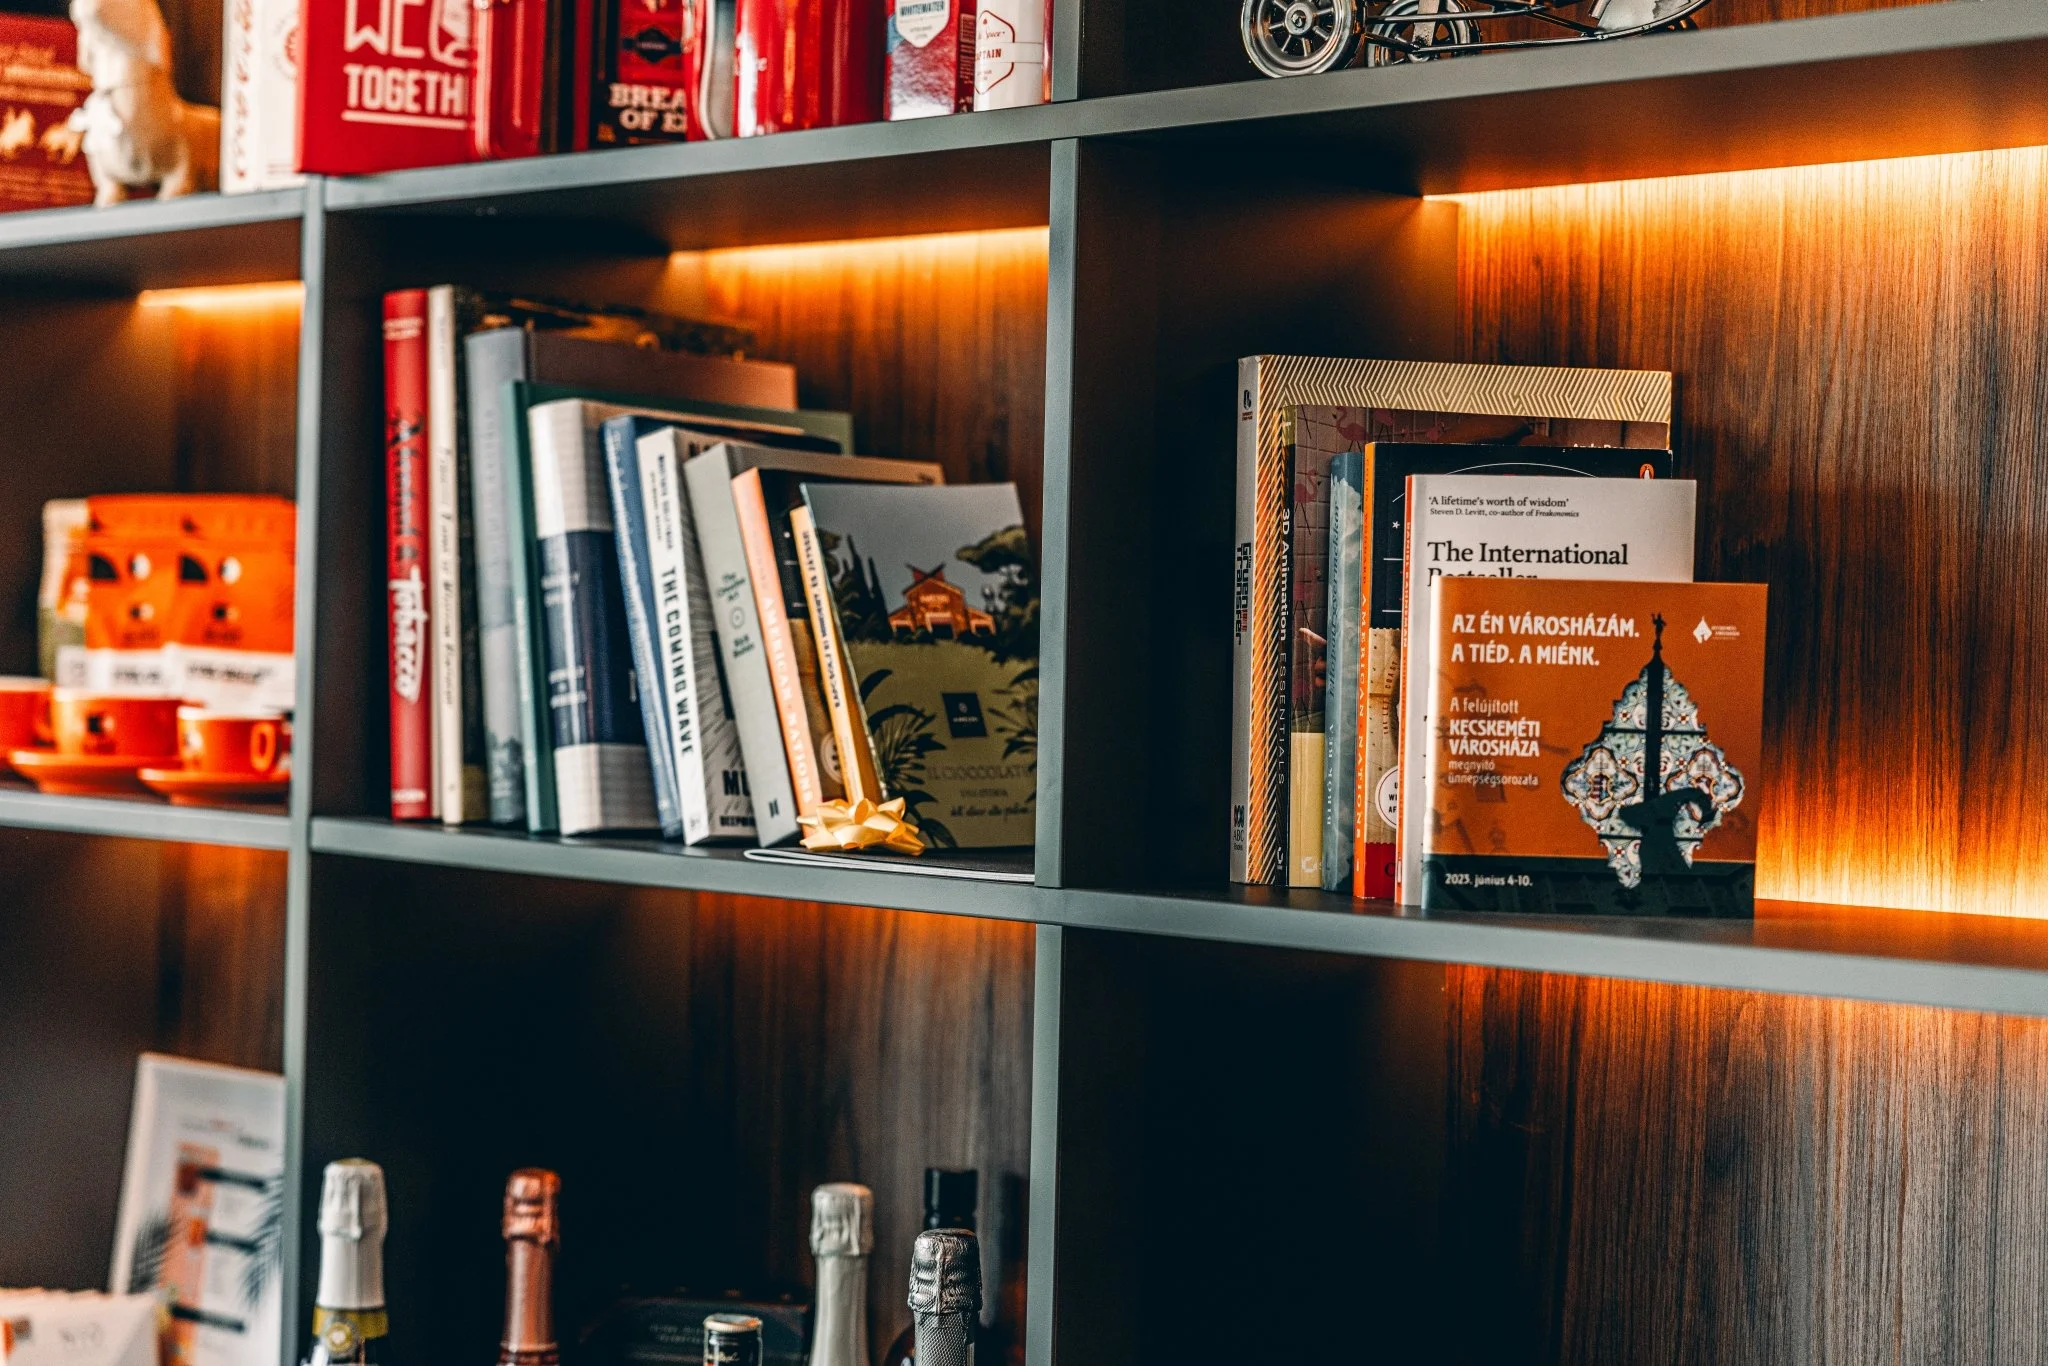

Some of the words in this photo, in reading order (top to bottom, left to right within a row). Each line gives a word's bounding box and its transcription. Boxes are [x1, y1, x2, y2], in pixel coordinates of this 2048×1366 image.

[343, 63, 469, 117] TOGETH
[1430, 508, 1453, 516] Steven
[1455, 508, 1463, 516] D.
[1489, 509, 1524, 518] co-author
[1526, 510, 1535, 518] of
[1535, 510, 1580, 518] Freakonomics
[1485, 496, 1514, 507] worth
[1516, 496, 1527, 507] of
[1282, 507, 1291, 535] 3D
[1427, 541, 1474, 563] The
[1479, 542, 1629, 566] International
[661, 568, 679, 606] THE
[1240, 542, 1252, 609] Gruen
[1279, 541, 1290, 640] Animation
[389, 566, 428, 704] Tobacco
[1452, 614, 1475, 634] AZ
[1480, 608, 1504, 634] ÉN
[1508, 610, 1640, 638] VÁROSHÁZÁM.
[665, 609, 688, 694] COMING
[1359, 595, 1368, 717] AMERICAN
[1451, 644, 1465, 663] A
[1468, 639, 1515, 664] TIÉD.
[1519, 646, 1533, 664] A
[1536, 640, 1600, 666] MIÉNK.
[1278, 652, 1287, 785] ESSENTIALS
[1449, 698, 1460, 713] A
[1463, 698, 1519, 717] felújított
[675, 698, 696, 756] WAVE
[1449, 717, 1541, 737] KECSKEMÉTI
[1449, 736, 1540, 757] VÁROSHÁZA
[1448, 759, 1496, 772] megnyitó
[1448, 772, 1539, 787] ünnepségsorozata
[1355, 735, 1364, 838] NATIONS
[1233, 829, 1245, 842] ABC
[1474, 873, 1506, 888] június
[1507, 874, 1533, 886] 4-10.
